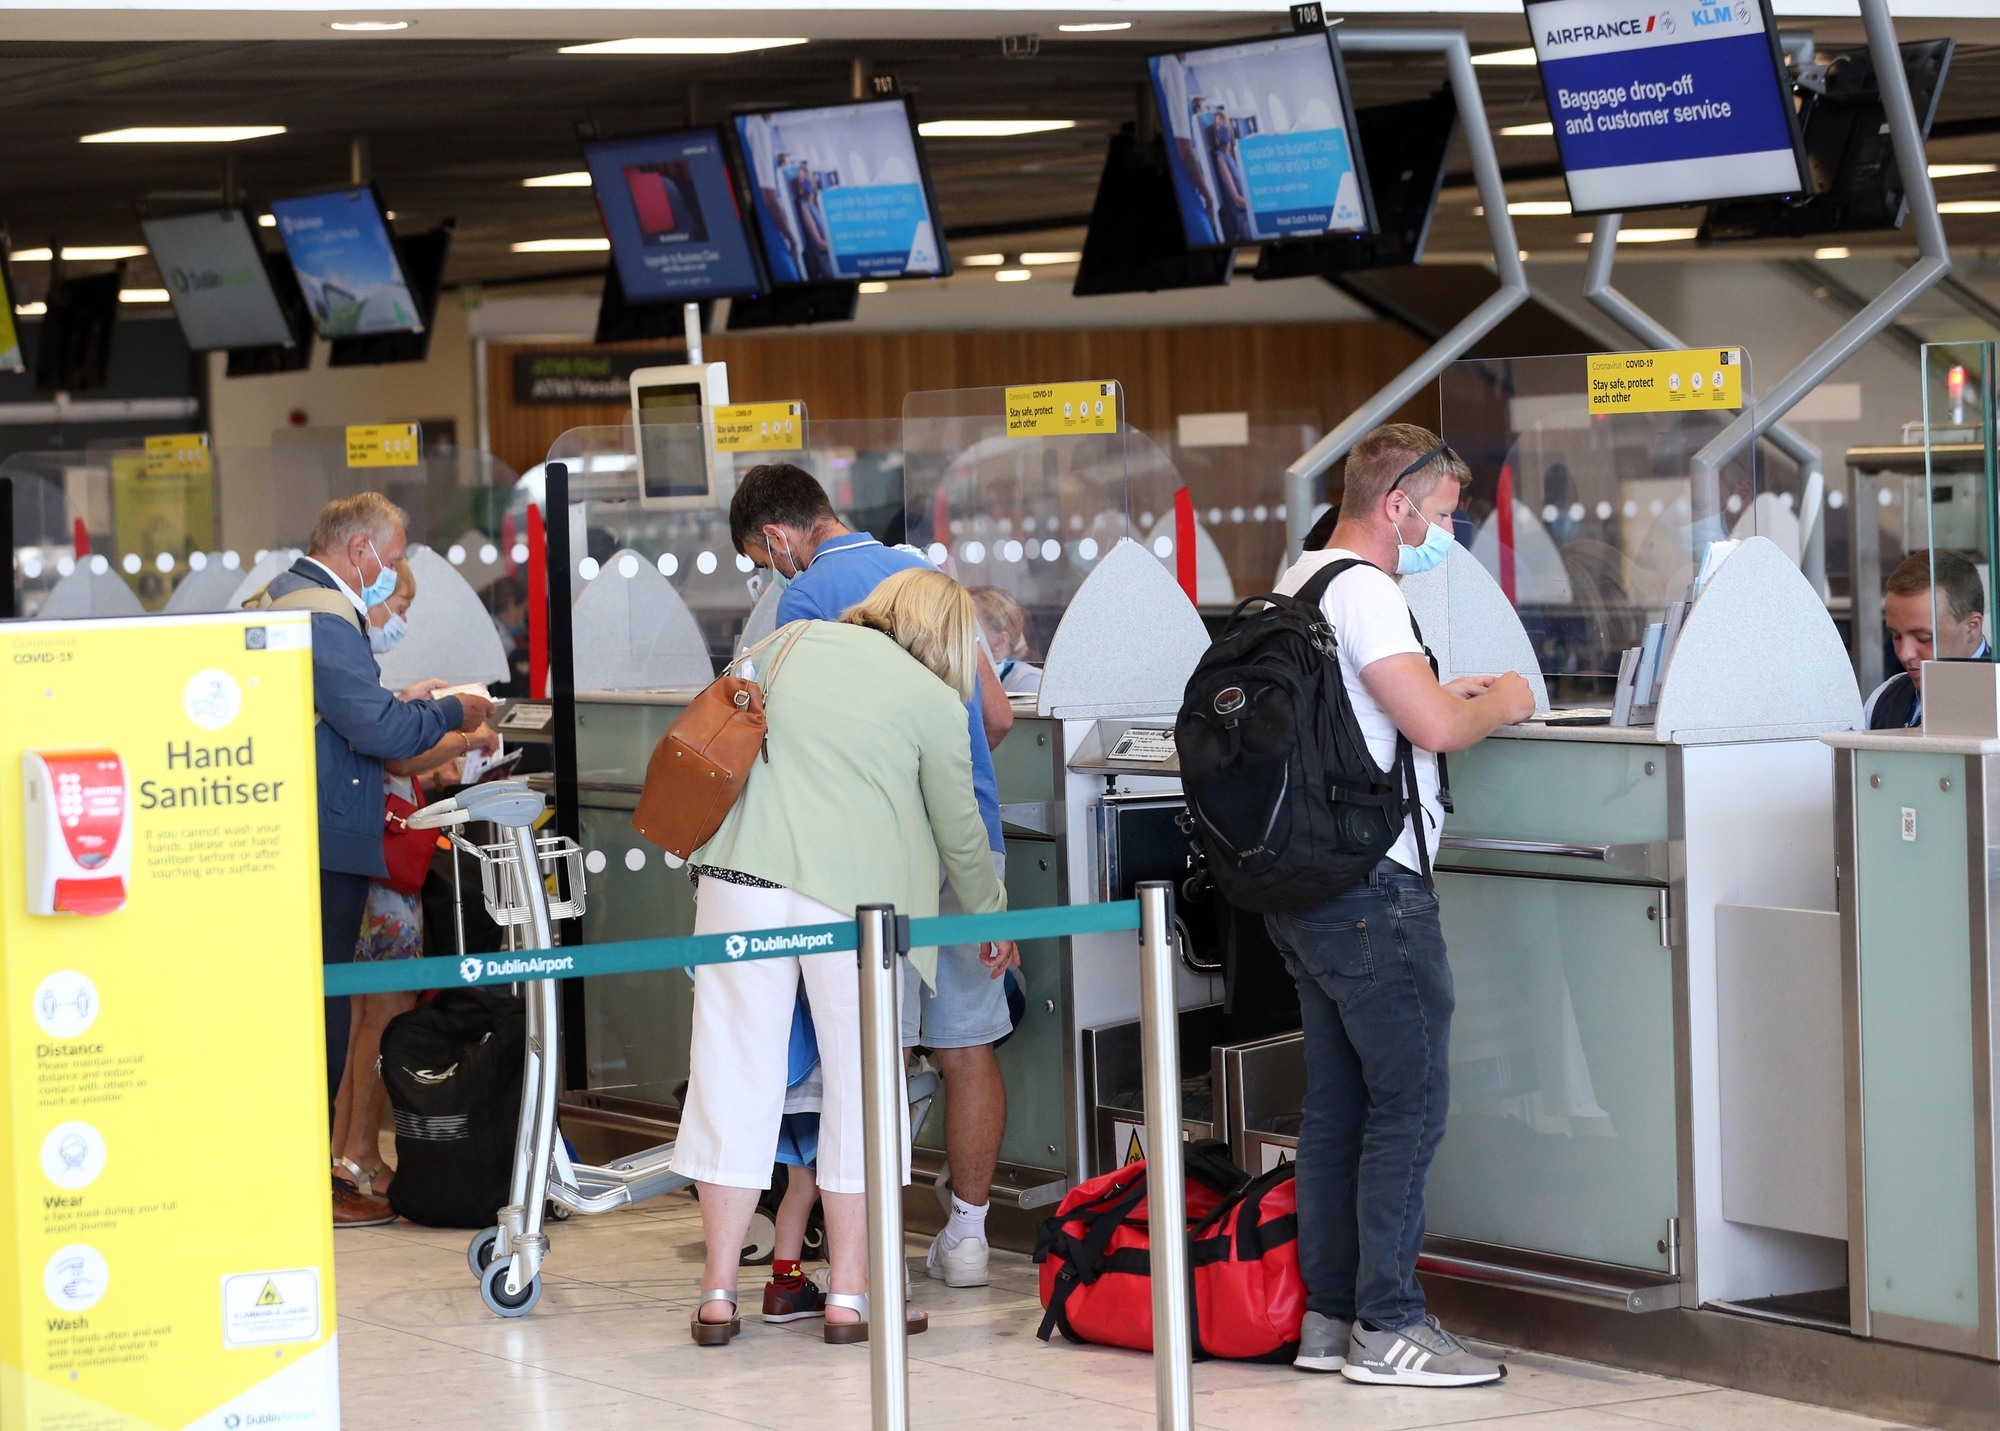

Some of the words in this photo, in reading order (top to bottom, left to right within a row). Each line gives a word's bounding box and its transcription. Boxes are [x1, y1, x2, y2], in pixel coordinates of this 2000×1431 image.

[1297, 5, 1318, 24] 708
[1692, 6, 1733, 27] KLM
[1546, 19, 1642, 46] AIRFRANCE
[1558, 86, 1627, 112] Baggage
[1630, 73, 1694, 102] drop-off
[1565, 113, 1595, 135] and
[1596, 106, 1670, 132] customer
[1673, 99, 1732, 124] service
[1592, 362, 1622, 371] Coronavirus
[1625, 359, 1653, 369] COVID-19
[1593, 379, 1608, 391] Stay
[1609, 378, 1627, 390] safe,
[1628, 377, 1654, 390] protect
[1032, 390, 1053, 399] COVID-19
[1593, 392, 1610, 404] each
[1611, 392, 1631, 403] other
[1010, 408, 1021, 418] Stay
[1034, 406, 1053, 417] protect
[1010, 420, 1022, 429] each
[1023, 419, 1037, 428] other
[13, 651, 74, 664] COVID-19
[167, 736, 253, 770] Hand
[140, 775, 284, 810] Sanitiser
[750, 932, 834, 953] DublinAirport
[486, 957, 575, 977] DublinAirport
[37, 1043, 105, 1058] Distance
[43, 1195, 84, 1209] Wear
[46, 1315, 89, 1332] Wash
